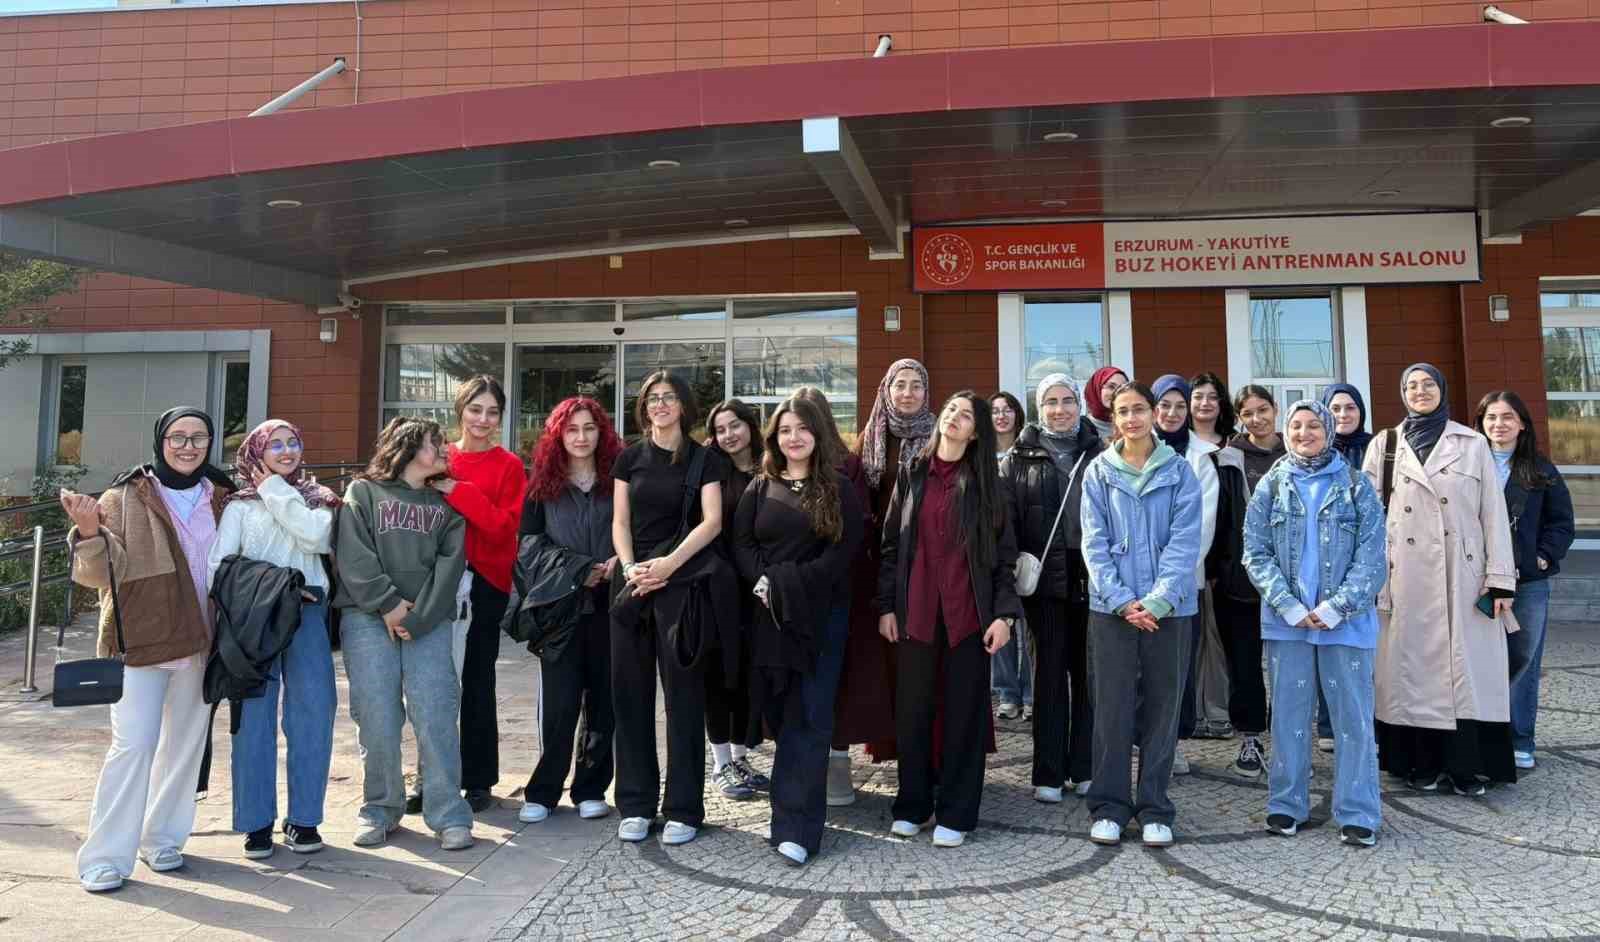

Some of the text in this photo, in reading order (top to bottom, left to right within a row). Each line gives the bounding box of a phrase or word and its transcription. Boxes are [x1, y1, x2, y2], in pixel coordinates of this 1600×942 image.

[984, 241, 1077, 256] T.C. GENÇLİK VE
[1114, 239, 1193, 252] ERZURUM
[1207, 234, 1289, 250] YAKUTİYE
[984, 256, 1086, 271] SPOR BAKANLIĞI
[1115, 249, 1466, 273] BUZ HOKEYİ ANTRENMAN SALONU
